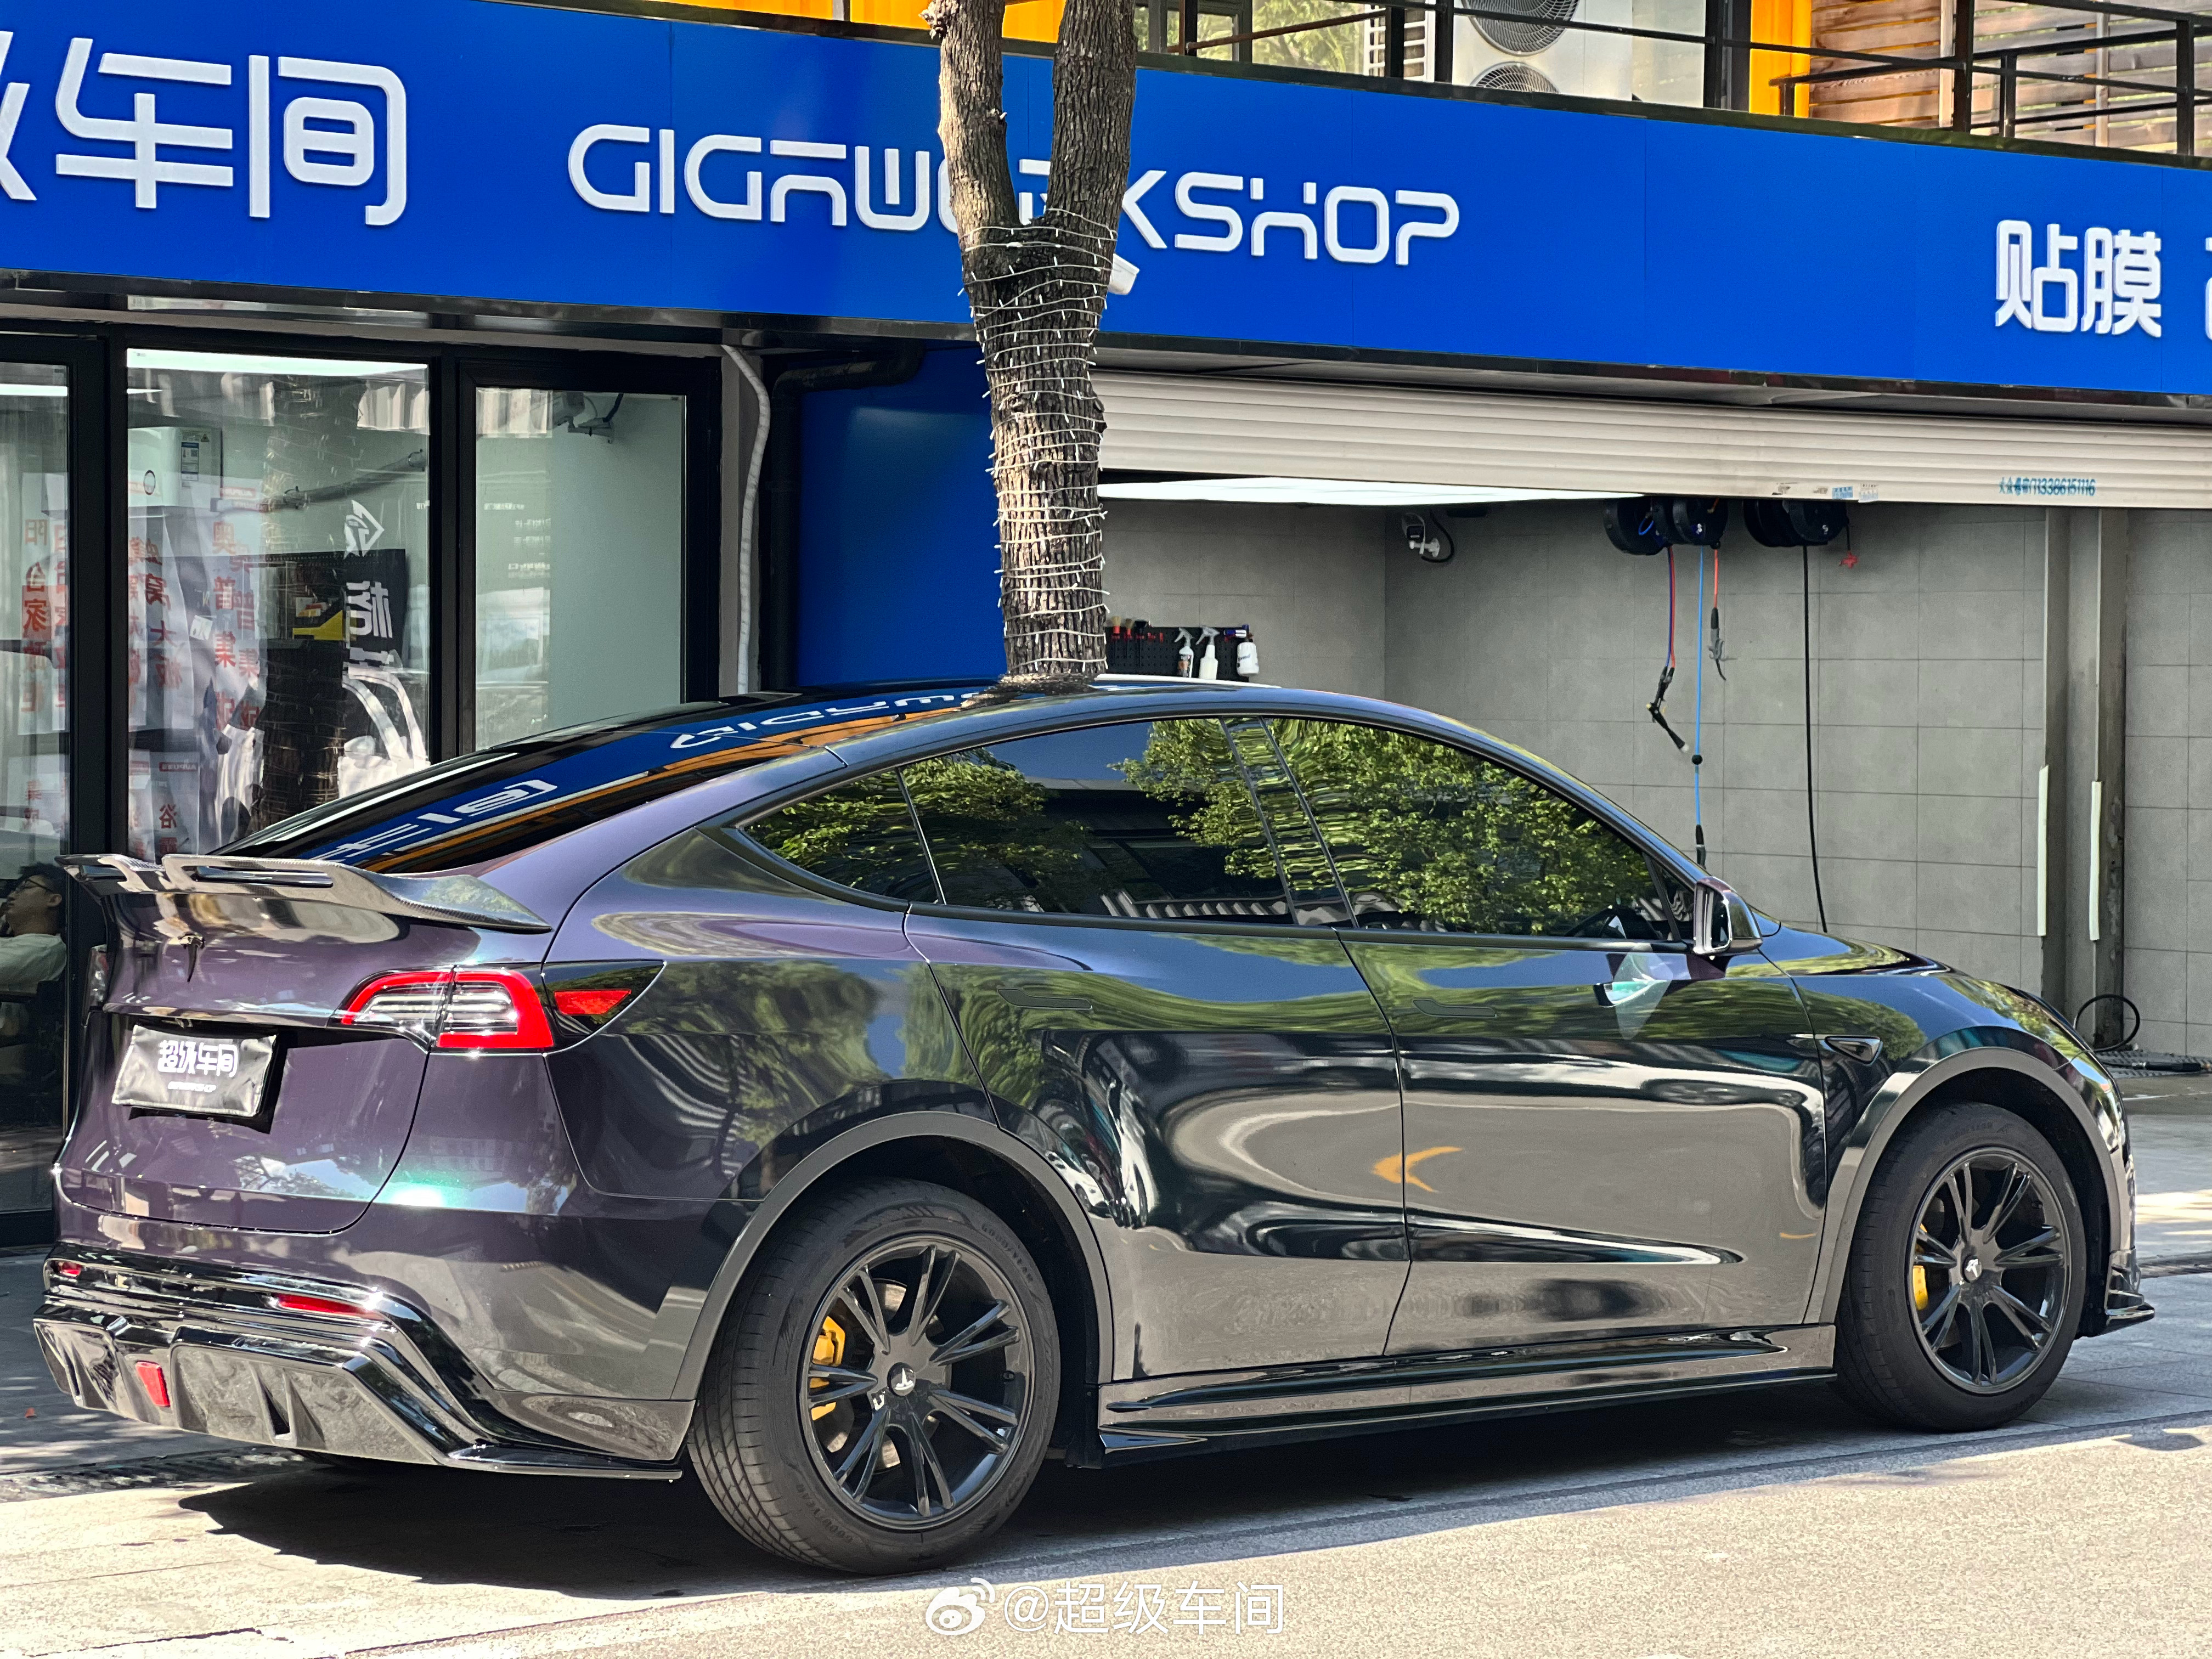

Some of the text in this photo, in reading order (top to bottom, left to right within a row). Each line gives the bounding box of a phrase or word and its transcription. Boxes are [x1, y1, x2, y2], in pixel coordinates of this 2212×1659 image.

[0, 31, 407, 226] 车间
[568, 123, 1460, 266] GIGAWKSHOP
[1995, 219, 2162, 338] 贴膜
[157, 1040, 239, 1077] 超级车间
